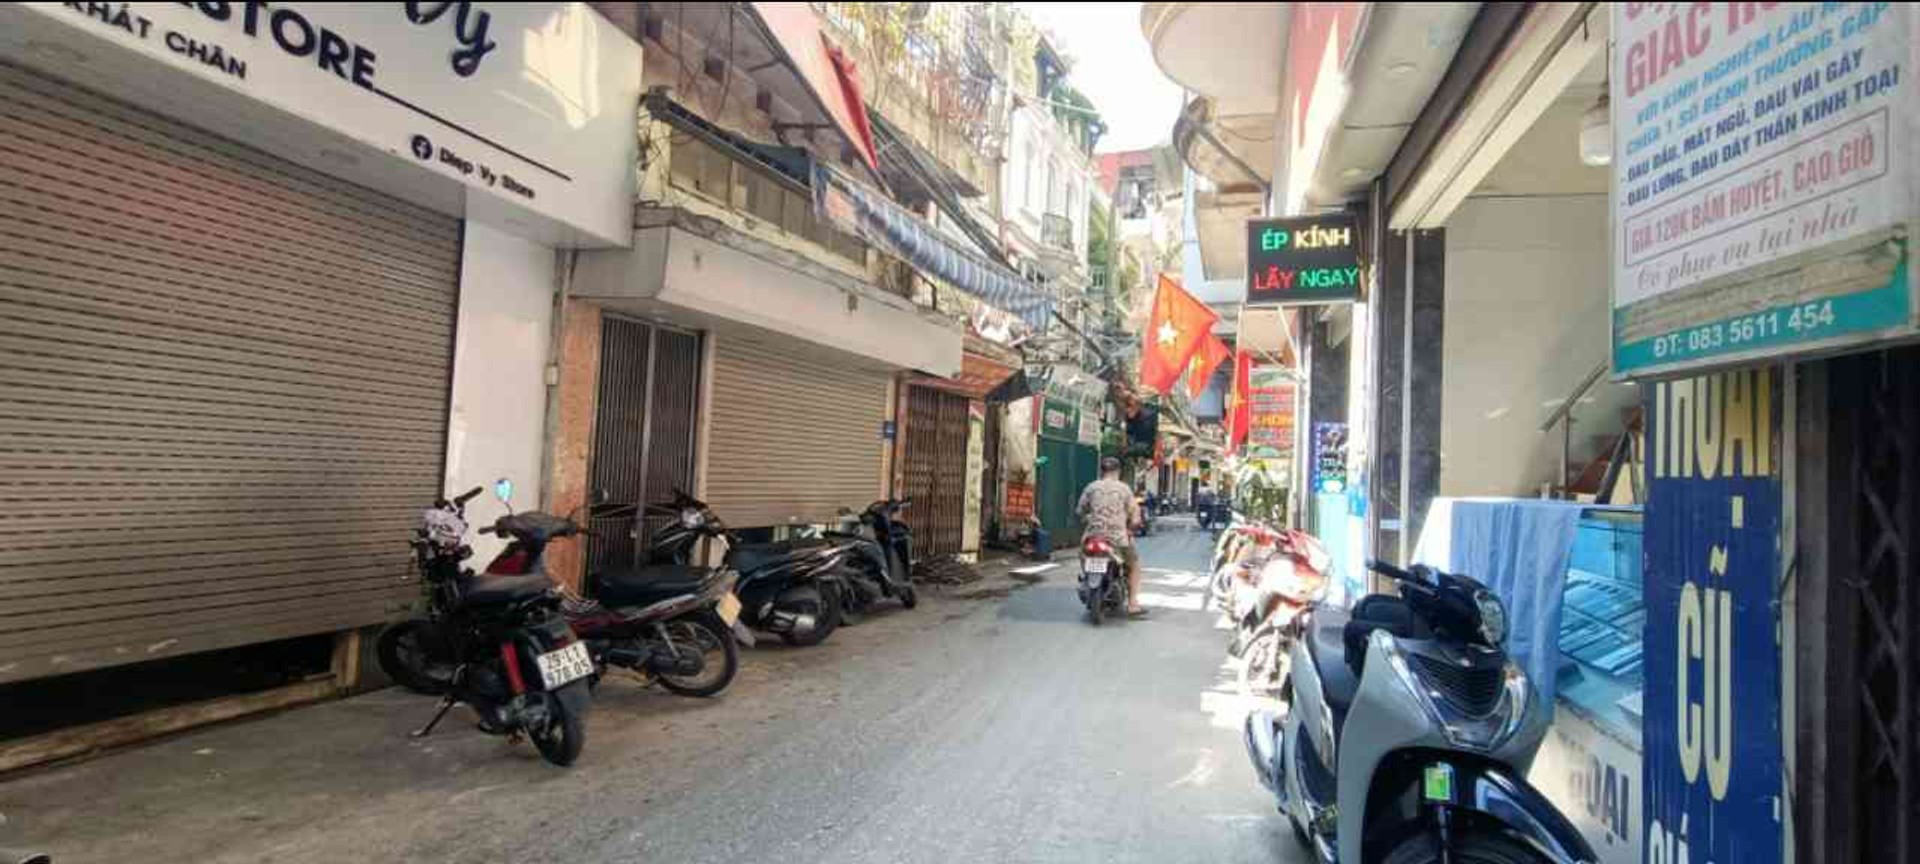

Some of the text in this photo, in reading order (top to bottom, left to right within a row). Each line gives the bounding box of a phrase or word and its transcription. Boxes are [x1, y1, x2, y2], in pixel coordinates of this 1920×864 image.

[1792, 68, 1820, 100] VAI
[1801, 88, 1848, 127] KINH
[1261, 223, 1350, 250] ÉP KÍNH
[1299, 266, 1358, 288] NGAY
[1688, 324, 1722, 350] 083
[1729, 312, 1778, 343] 5611
[1788, 299, 1835, 331] 454
[1677, 545, 1732, 801] CŨ
